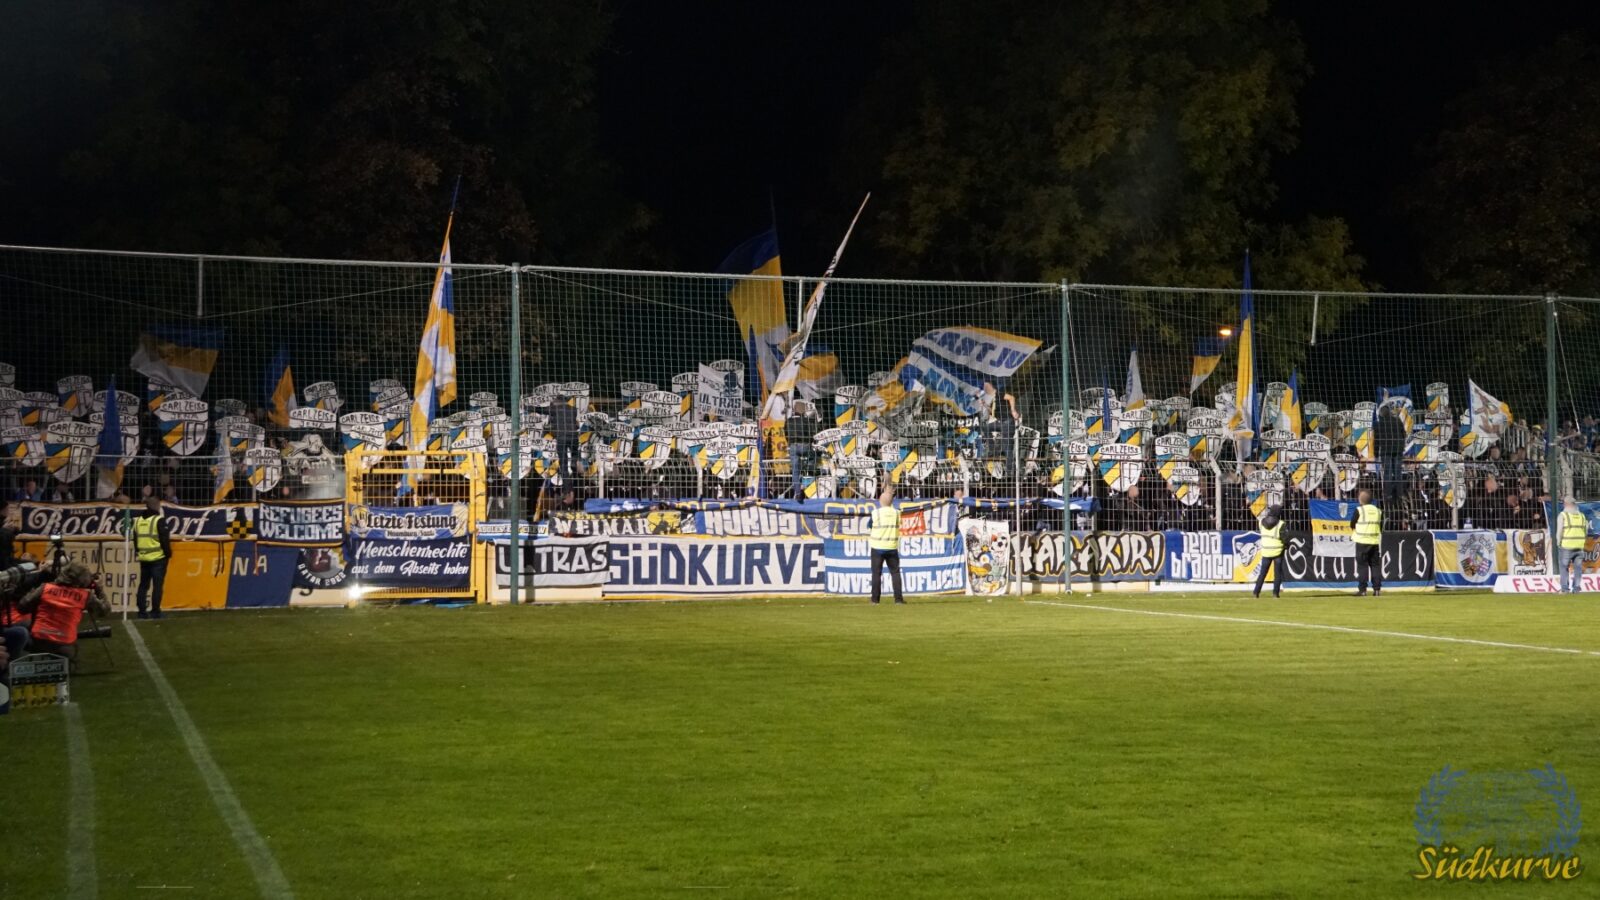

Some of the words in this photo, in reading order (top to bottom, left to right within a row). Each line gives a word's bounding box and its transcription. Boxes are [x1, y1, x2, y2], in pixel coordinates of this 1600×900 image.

[700, 392, 741, 409] ULTRAS
[28, 506, 218, 542] Rockeorf
[260, 503, 343, 524] REFUGEES
[367, 513, 403, 529] Letzte
[405, 513, 457, 530] Festung
[259, 521, 343, 541] WELCOME
[553, 516, 653, 536] WEIMAR
[355, 541, 470, 560] Menschenrechte
[843, 535, 946, 557] UNGSAM
[1010, 533, 1163, 573] HARAKIRI
[186, 555, 268, 577] JENA
[351, 564, 368, 574] aus
[374, 562, 395, 574] dem
[400, 560, 441, 576] Abseits
[443, 562, 469, 575] holen
[611, 542, 826, 586] SÜDKURVE
[1170, 551, 1233, 580] branco
[1283, 537, 1428, 580] Saaleld
[827, 567, 963, 593] UNVEKÄUFLICH
